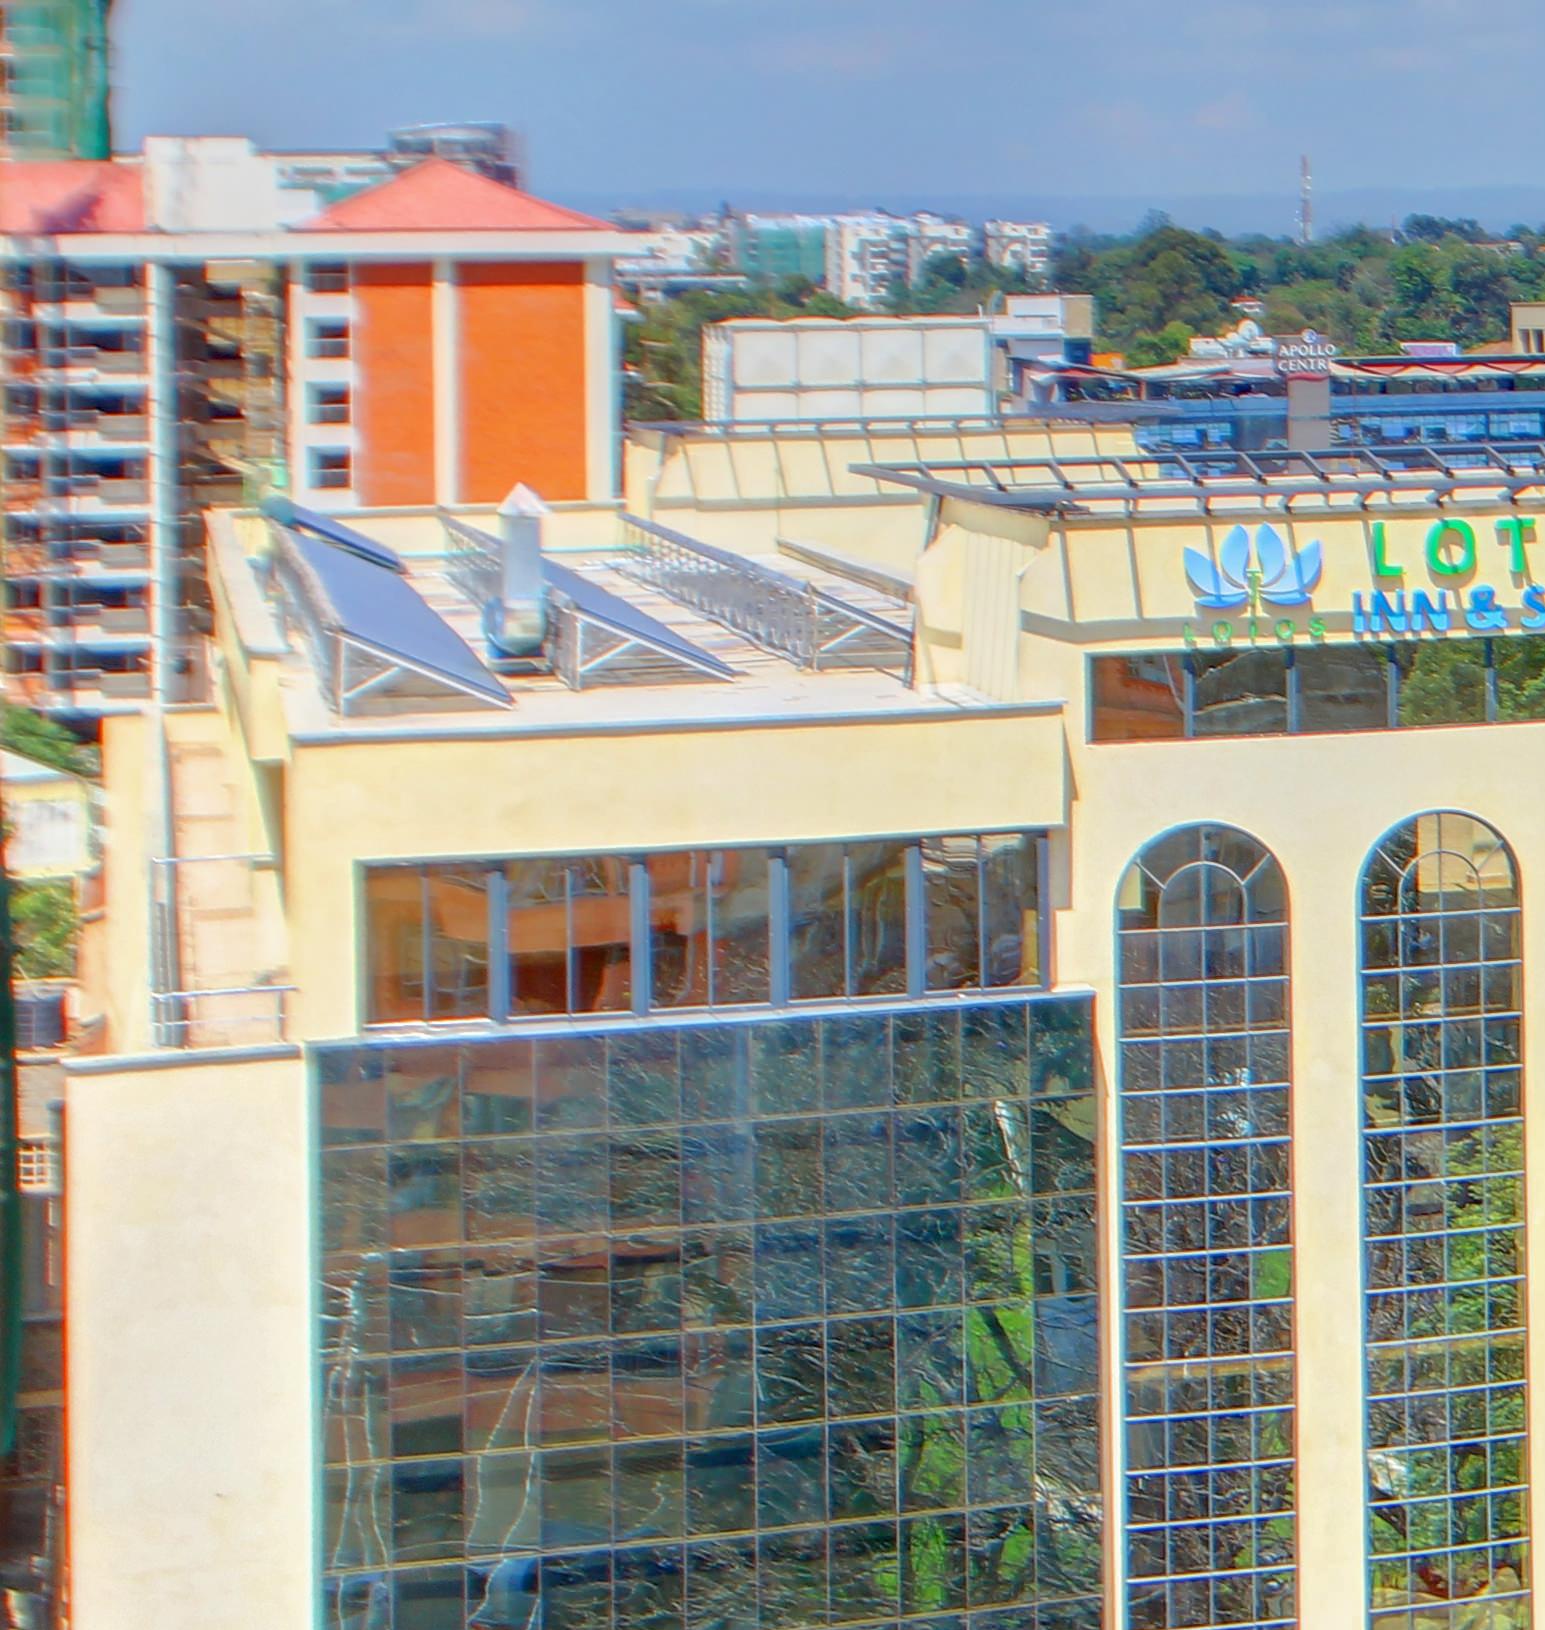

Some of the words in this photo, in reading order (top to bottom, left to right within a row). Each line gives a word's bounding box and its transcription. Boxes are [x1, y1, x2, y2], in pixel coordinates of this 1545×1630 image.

[1279, 344, 1335, 356] APOLLO
[1278, 359, 1335, 371] CENTR
[1353, 587, 1450, 633] INN
[1464, 584, 1508, 629] &
